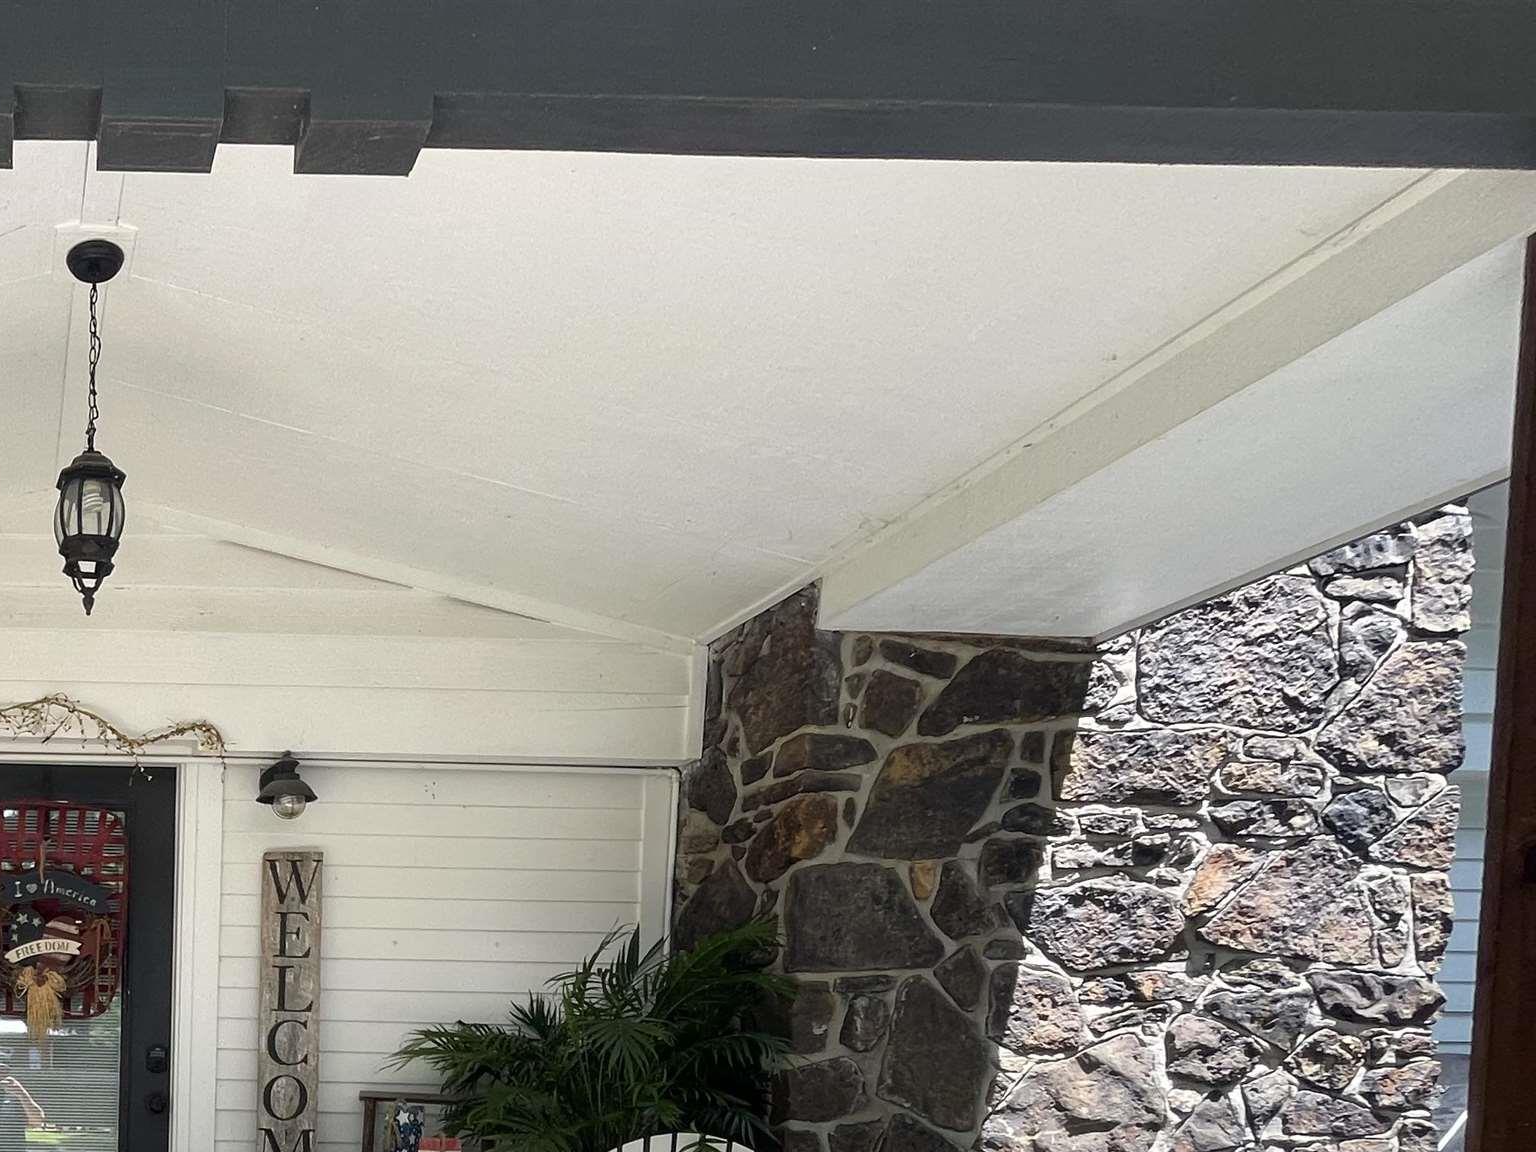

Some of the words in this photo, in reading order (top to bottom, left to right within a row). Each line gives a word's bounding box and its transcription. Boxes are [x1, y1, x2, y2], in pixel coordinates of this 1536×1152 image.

[14, 881, 23, 898] I
[43, 879, 97, 906] America
[15, 941, 70, 959] FREEDOM
